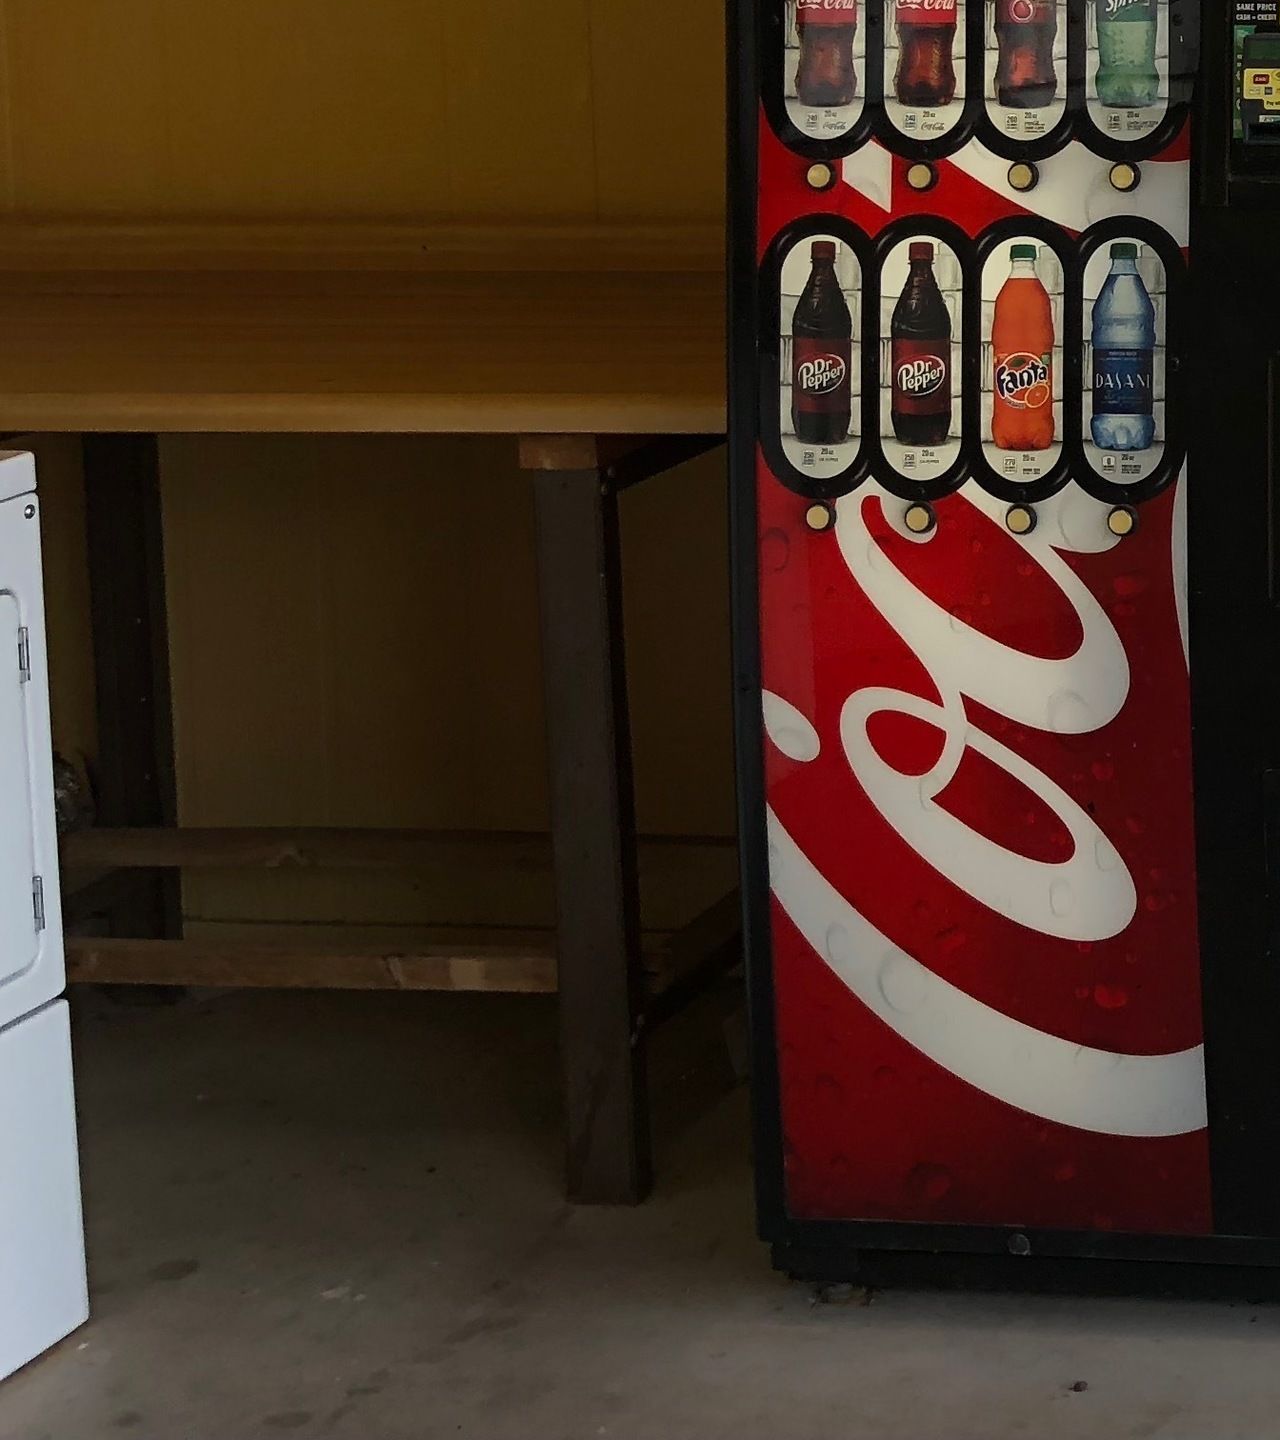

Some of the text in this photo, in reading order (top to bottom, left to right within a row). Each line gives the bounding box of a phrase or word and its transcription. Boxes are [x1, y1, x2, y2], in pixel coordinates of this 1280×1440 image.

[1236, 3, 1277, 11] SAME PRICE
[814, 359, 833, 375] Dr
[914, 360, 933, 376] Dr
[802, 362, 841, 390] Pepper
[902, 363, 941, 391] Pepper
[996, 361, 1048, 399] Fanta
[1096, 372, 1150, 389] DASANI
